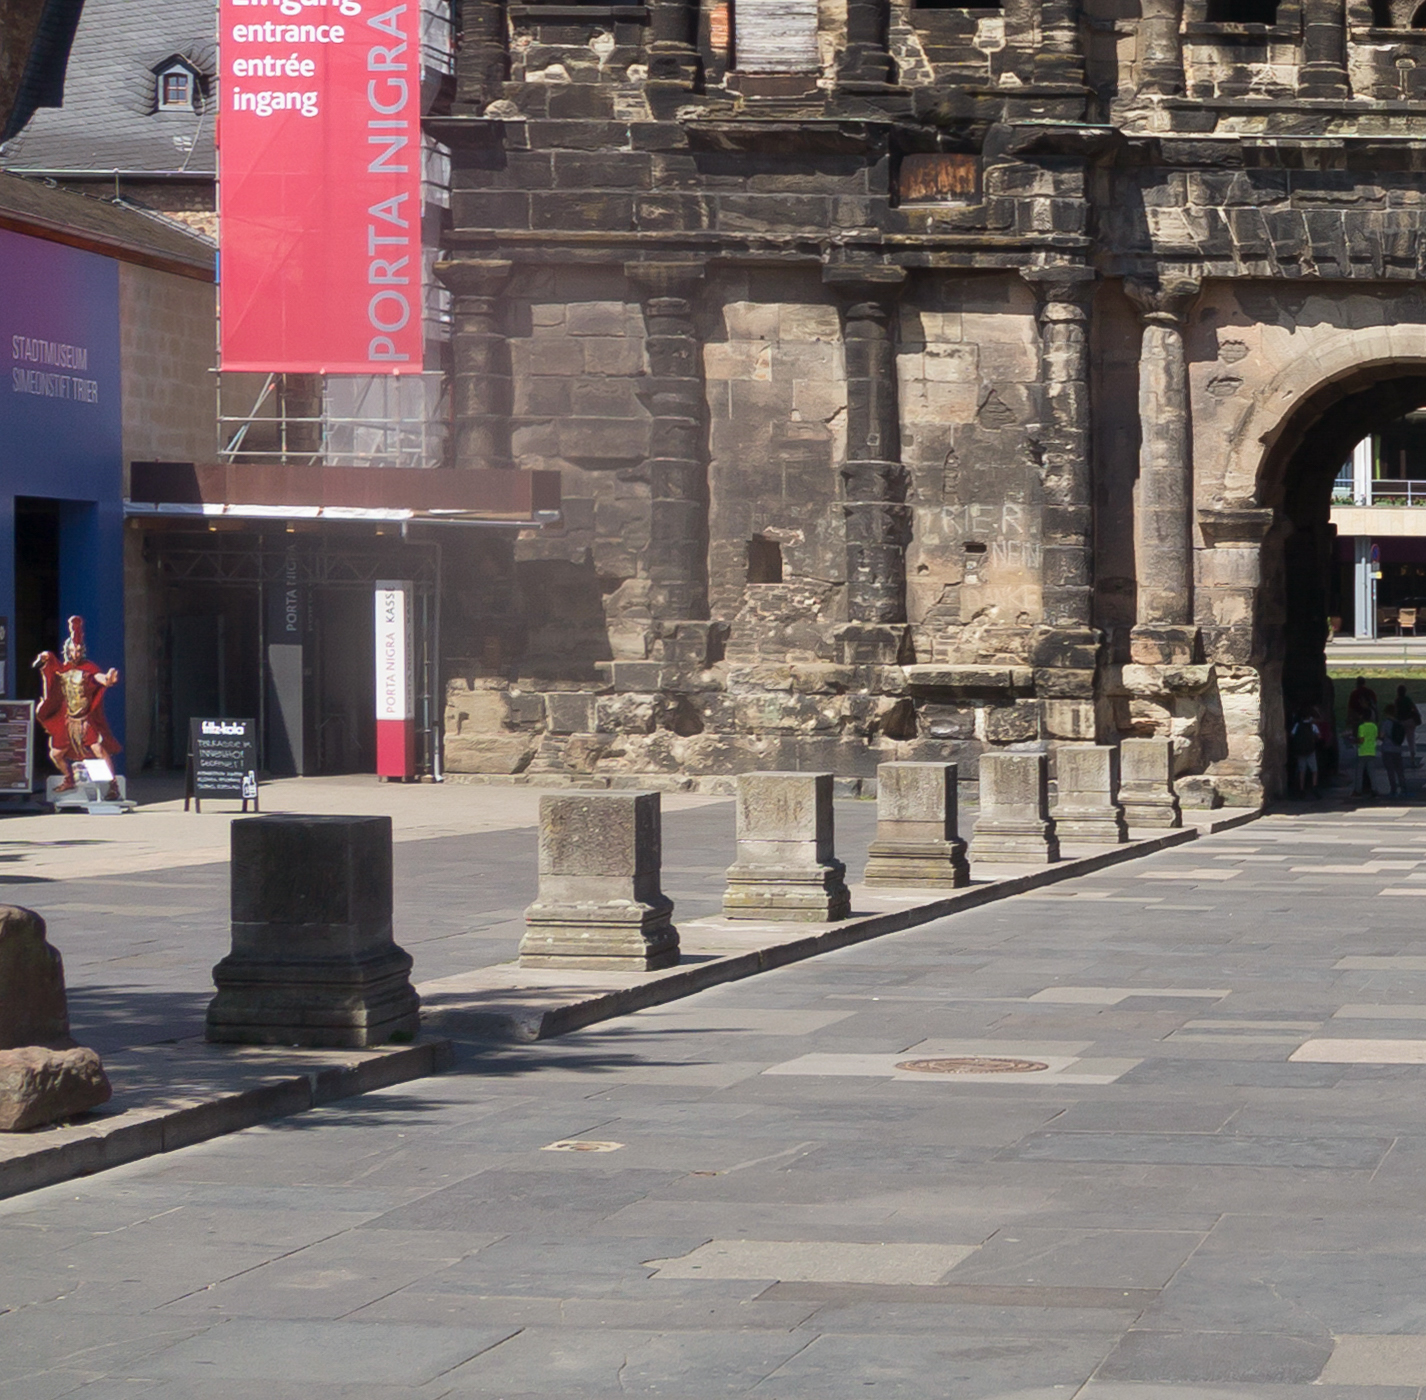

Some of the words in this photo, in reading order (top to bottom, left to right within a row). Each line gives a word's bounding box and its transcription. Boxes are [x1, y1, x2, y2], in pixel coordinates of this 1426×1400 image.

[232, 21, 345, 43] entrance
[232, 53, 315, 77] entrée
[232, 87, 319, 117] ingang
[367, 3, 408, 173] NIGRA
[368, 192, 410, 362] PORTA
[12, 334, 88, 371] STADTMUSEUM
[12, 367, 71, 399] SIMEONSTIFT
[72, 377, 98, 403] TRIER
[286, 589, 298, 632] PORTA
[386, 586, 396, 623] KASSE
[386, 632, 396, 671] NIGRA
[386, 673, 396, 713] PORTA
